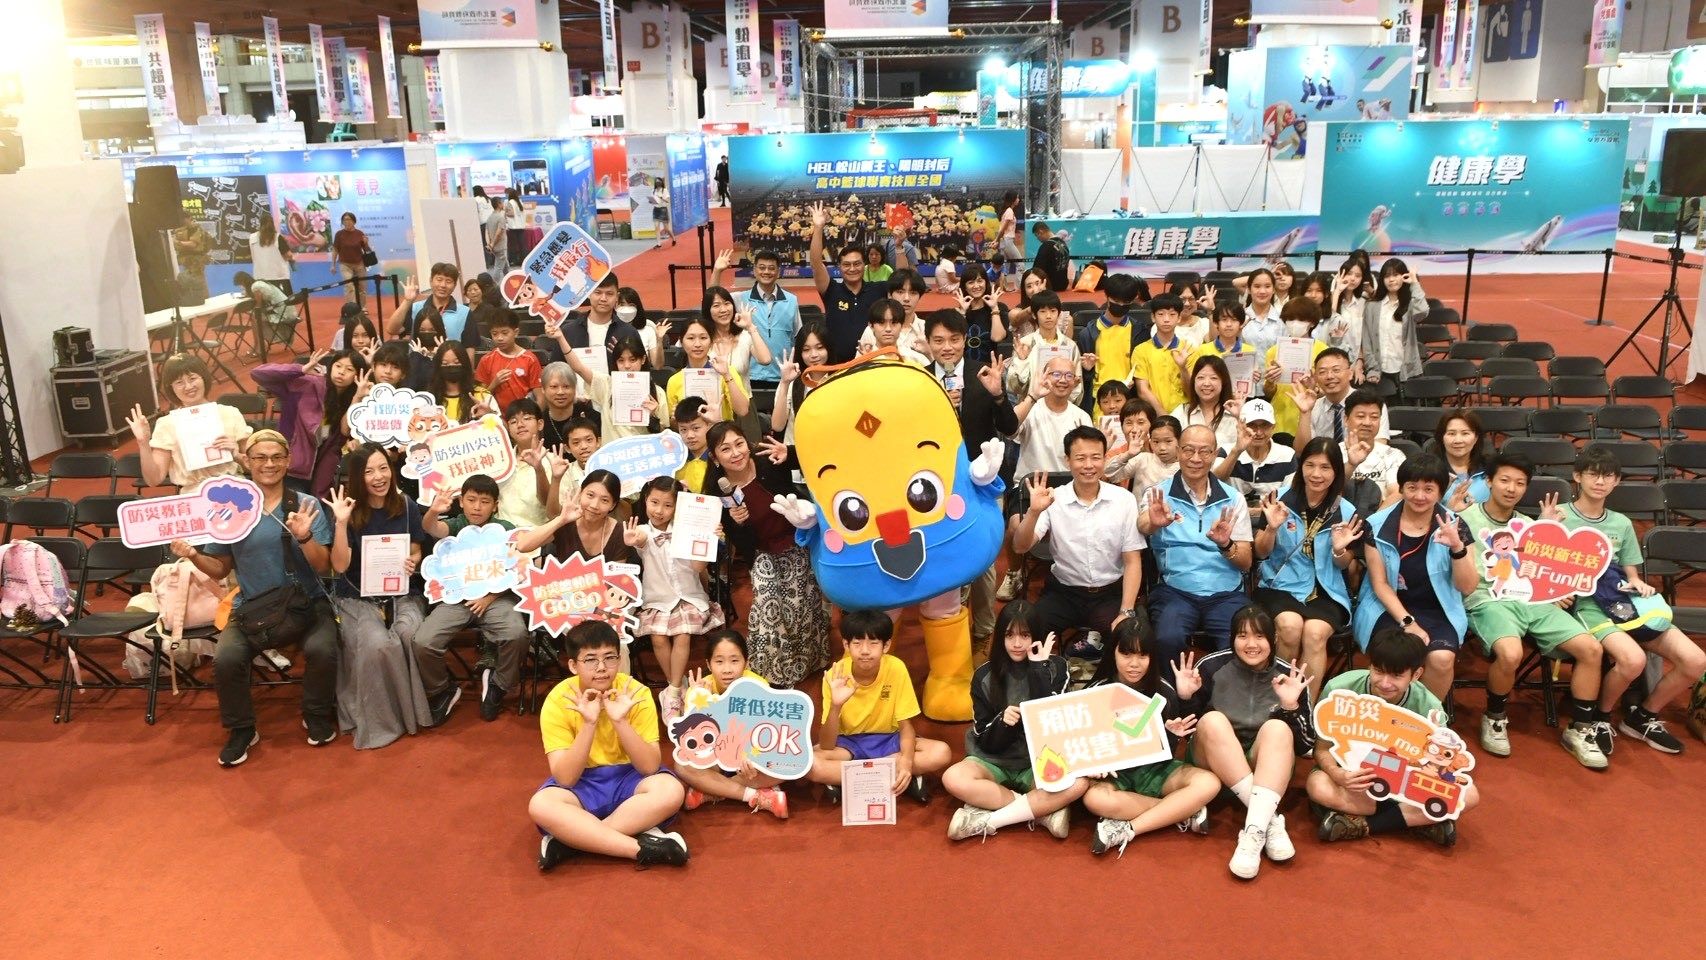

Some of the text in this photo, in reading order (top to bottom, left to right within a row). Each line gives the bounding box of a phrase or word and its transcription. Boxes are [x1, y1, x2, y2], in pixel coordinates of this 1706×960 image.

[1162, 5, 1181, 33] B
[641, 22, 660, 49] B
[1091, 37, 1105, 57] B
[1427, 155, 1527, 186] 健康學
[529, 231, 572, 275] 緊急應變
[1123, 226, 1221, 256] 健康學
[550, 239, 591, 281] 我最行
[434, 436, 501, 462] 防災小尖兵
[128, 501, 192, 524] 防災教育
[158, 518, 206, 537] 就是帥
[1524, 540, 1601, 569] 防災新生活
[464, 559, 505, 584] 起來
[541, 591, 601, 618] GoGo
[728, 696, 804, 721] 降低災害
[1038, 703, 1092, 736] 預防
[1334, 697, 1381, 722] 防災
[1064, 732, 1120, 765] 災害
[1327, 721, 1391, 743] Follow
[1394, 737, 1421, 756] me
